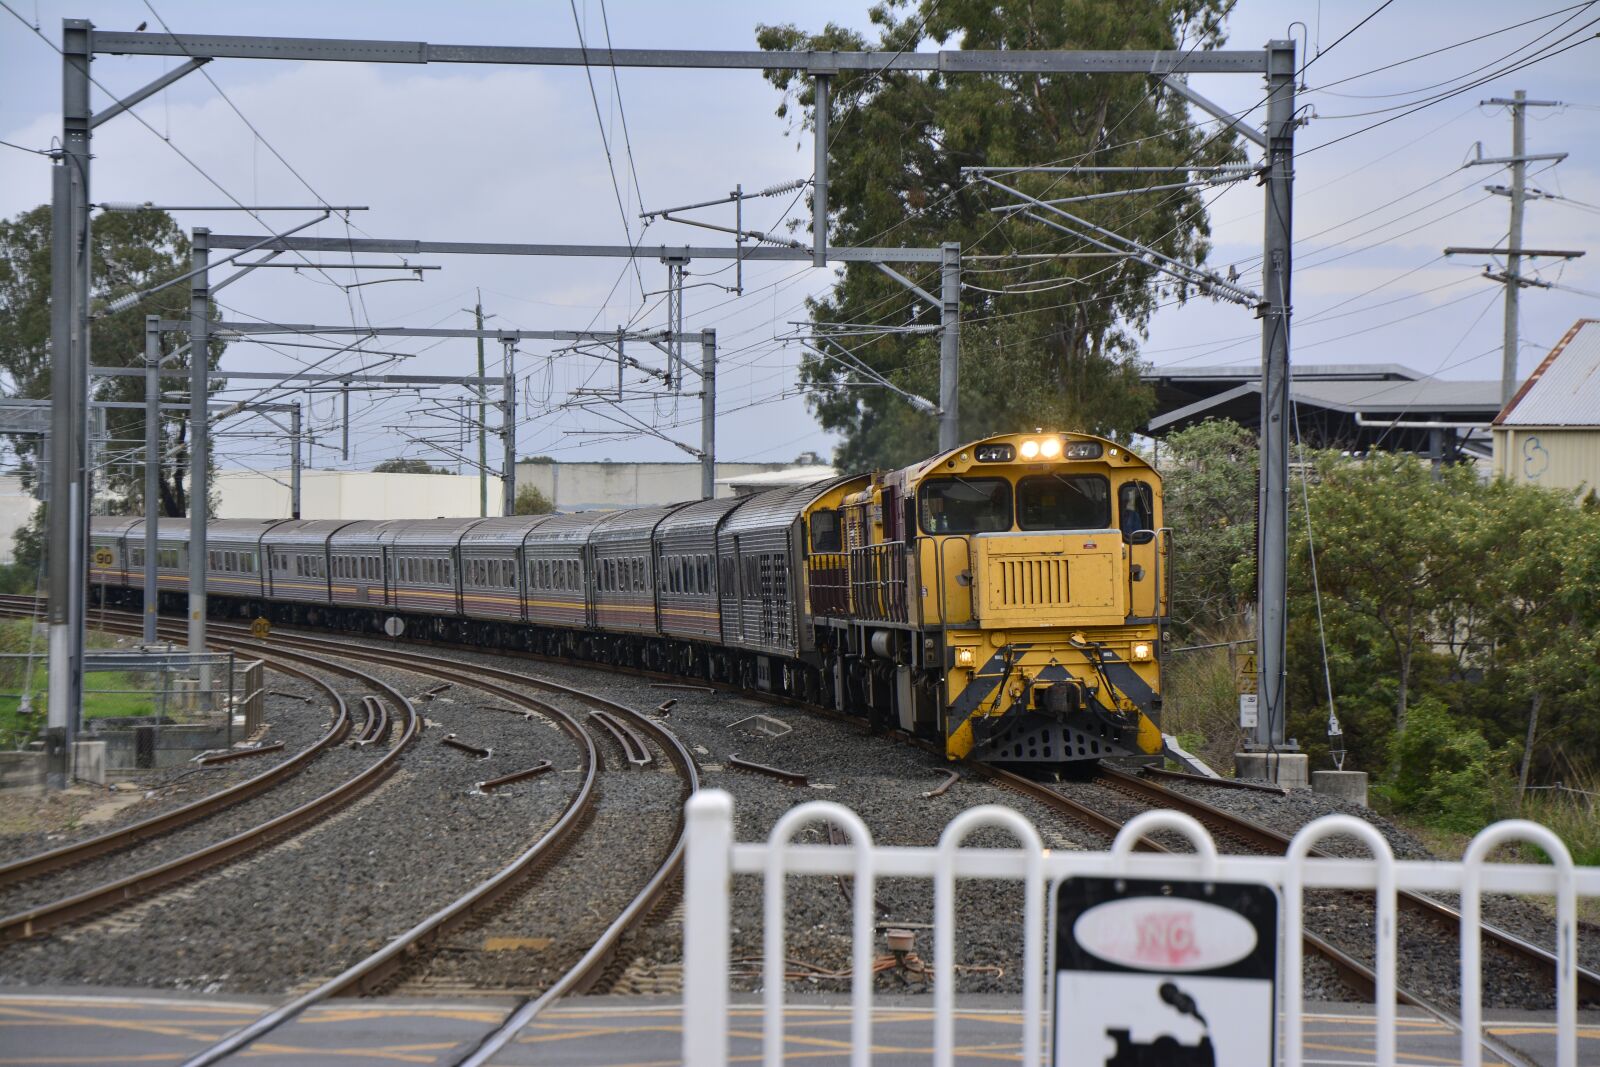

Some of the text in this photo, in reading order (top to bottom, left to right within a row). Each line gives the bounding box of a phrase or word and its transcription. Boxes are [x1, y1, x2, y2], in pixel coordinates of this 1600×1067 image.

[979, 447, 1011, 459] 2471
[1067, 444, 1098, 457] 2471
[96, 553, 112, 565] 90
